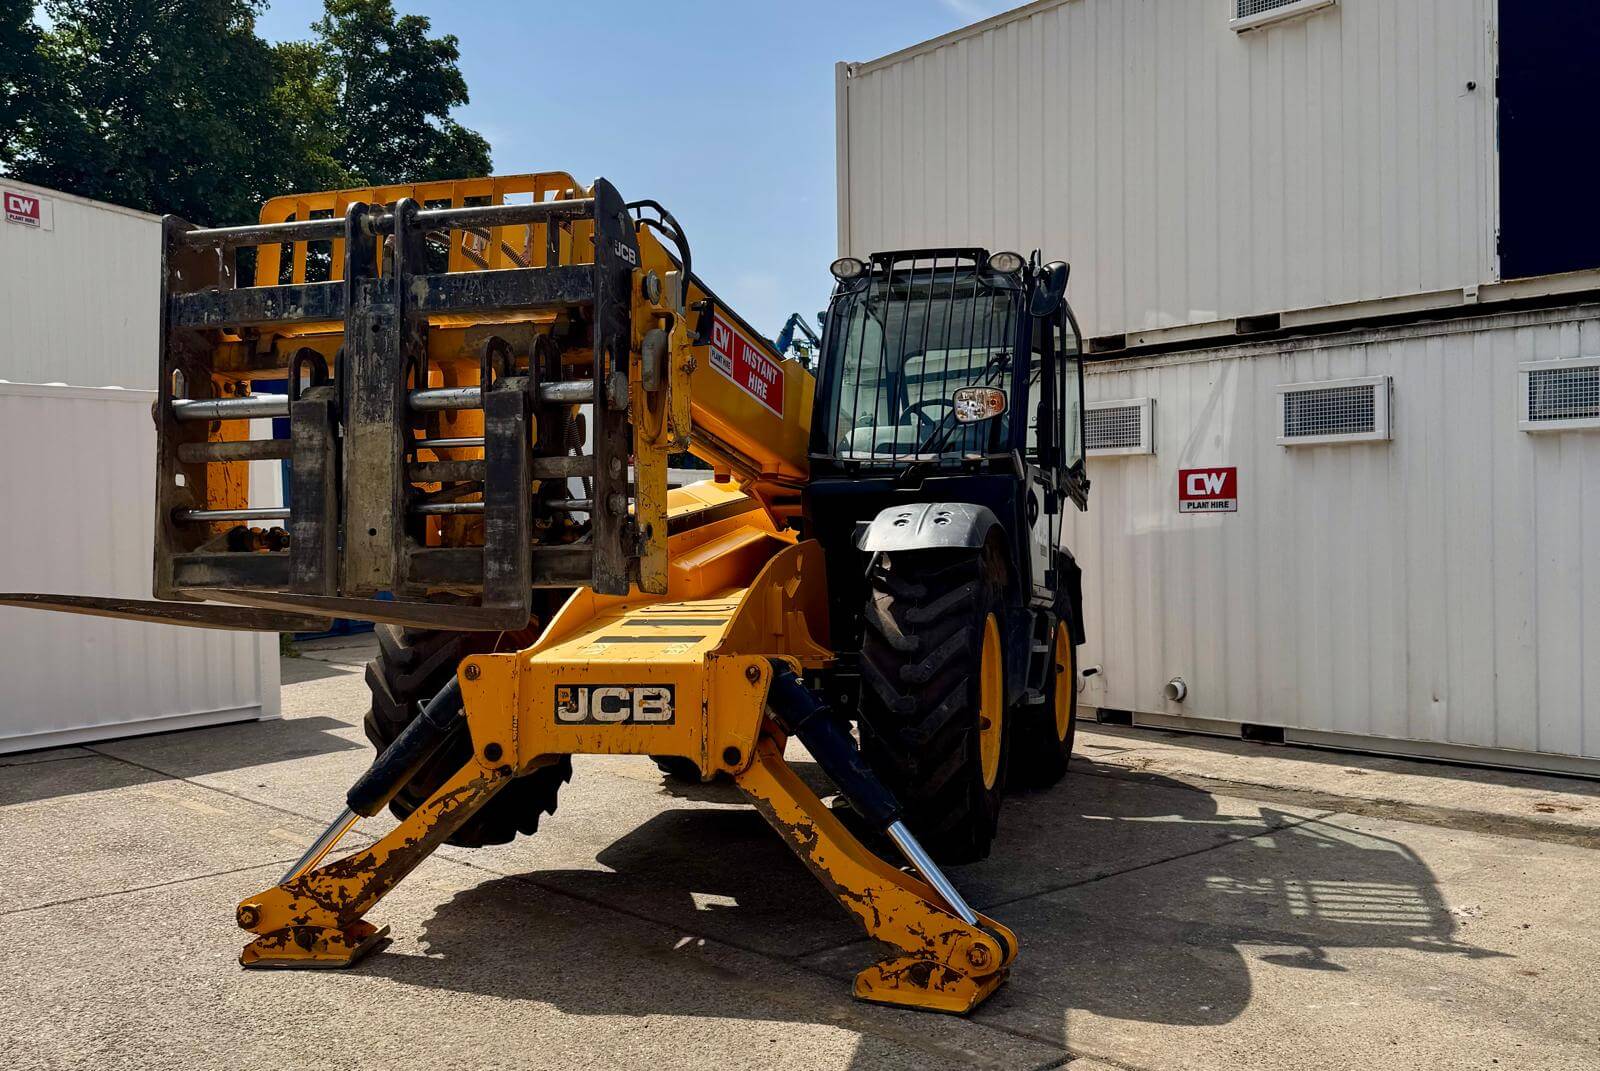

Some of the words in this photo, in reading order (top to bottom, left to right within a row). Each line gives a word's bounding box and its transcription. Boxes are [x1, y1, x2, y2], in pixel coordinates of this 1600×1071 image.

[9, 196, 34, 215] CW
[614, 240, 636, 265] JCB
[713, 320, 730, 353] CW
[742, 344, 778, 385] INSTANT
[748, 371, 768, 400] HIRE
[1186, 472, 1227, 496] CW
[1187, 501, 1209, 510] PLANT
[1210, 500, 1230, 509] HIRE
[557, 687, 672, 722] JCB
